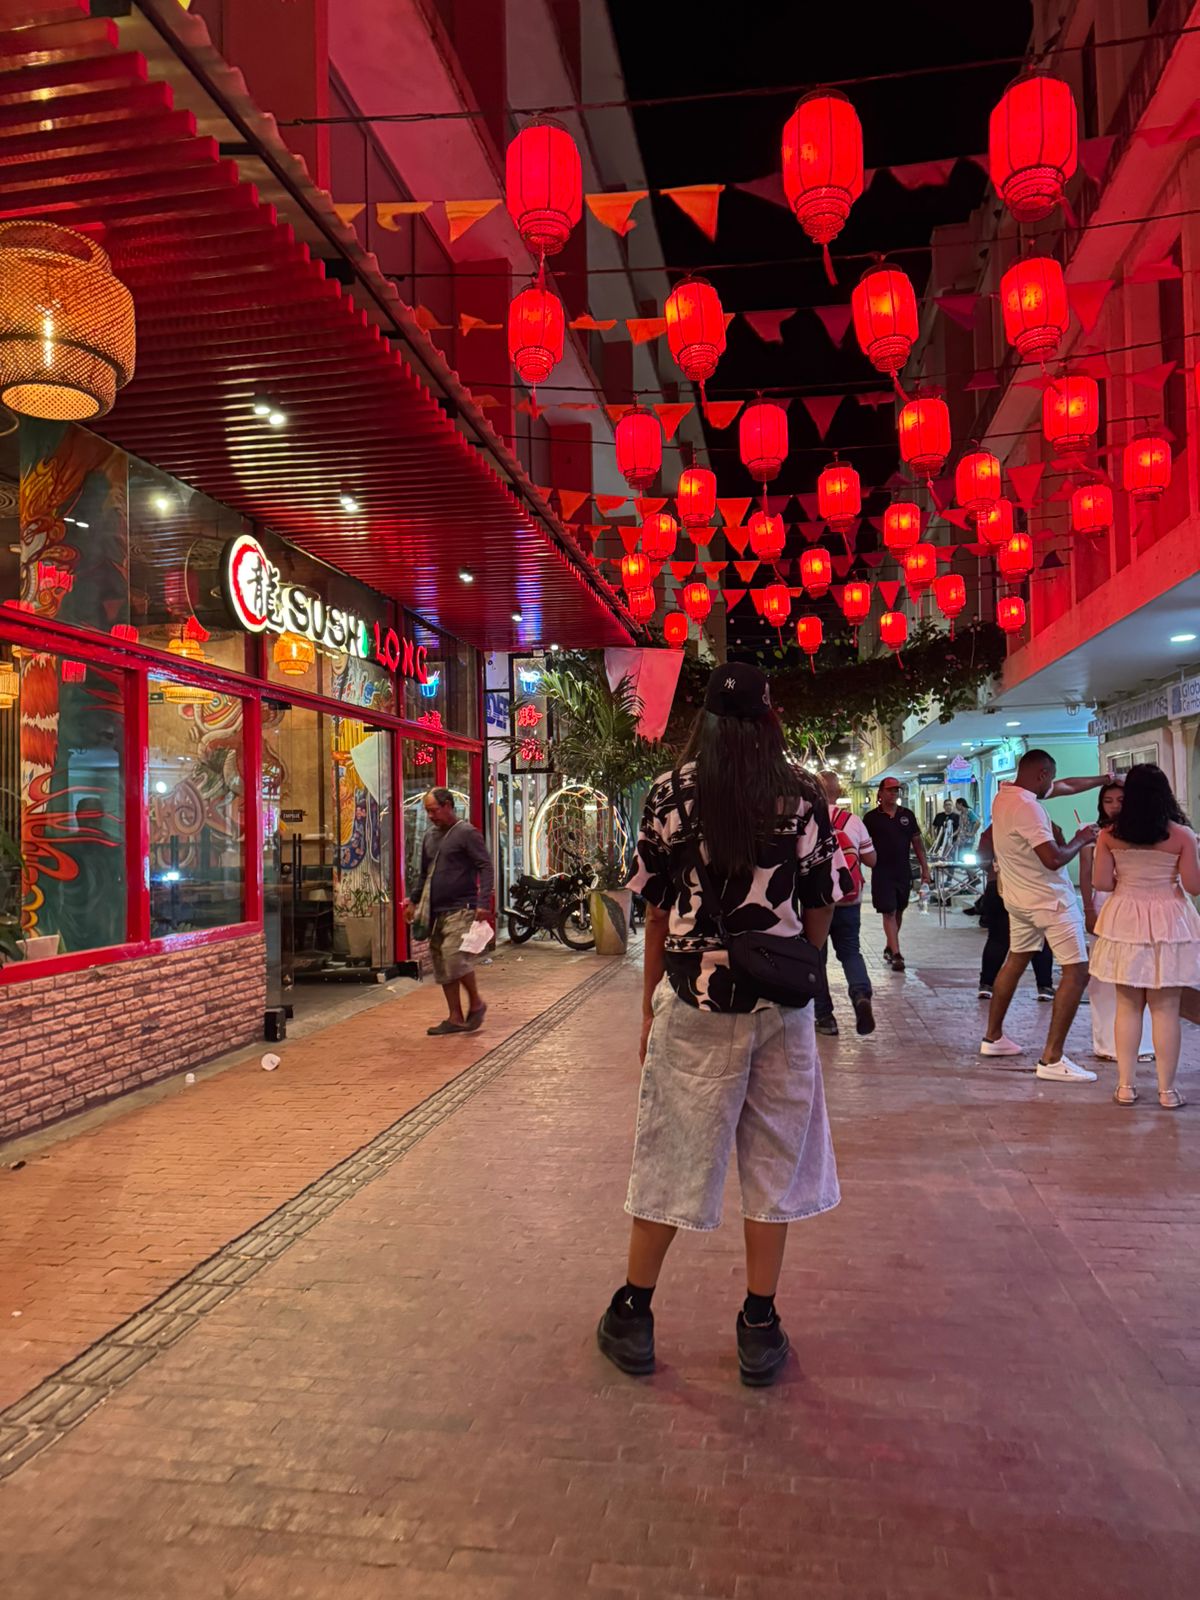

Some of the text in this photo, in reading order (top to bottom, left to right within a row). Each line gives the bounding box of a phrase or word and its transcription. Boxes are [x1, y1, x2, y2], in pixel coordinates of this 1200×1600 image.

[373, 620, 428, 684] LONG
[724, 677, 736, 690] NY
[1088, 709, 1121, 737] URRENCY
